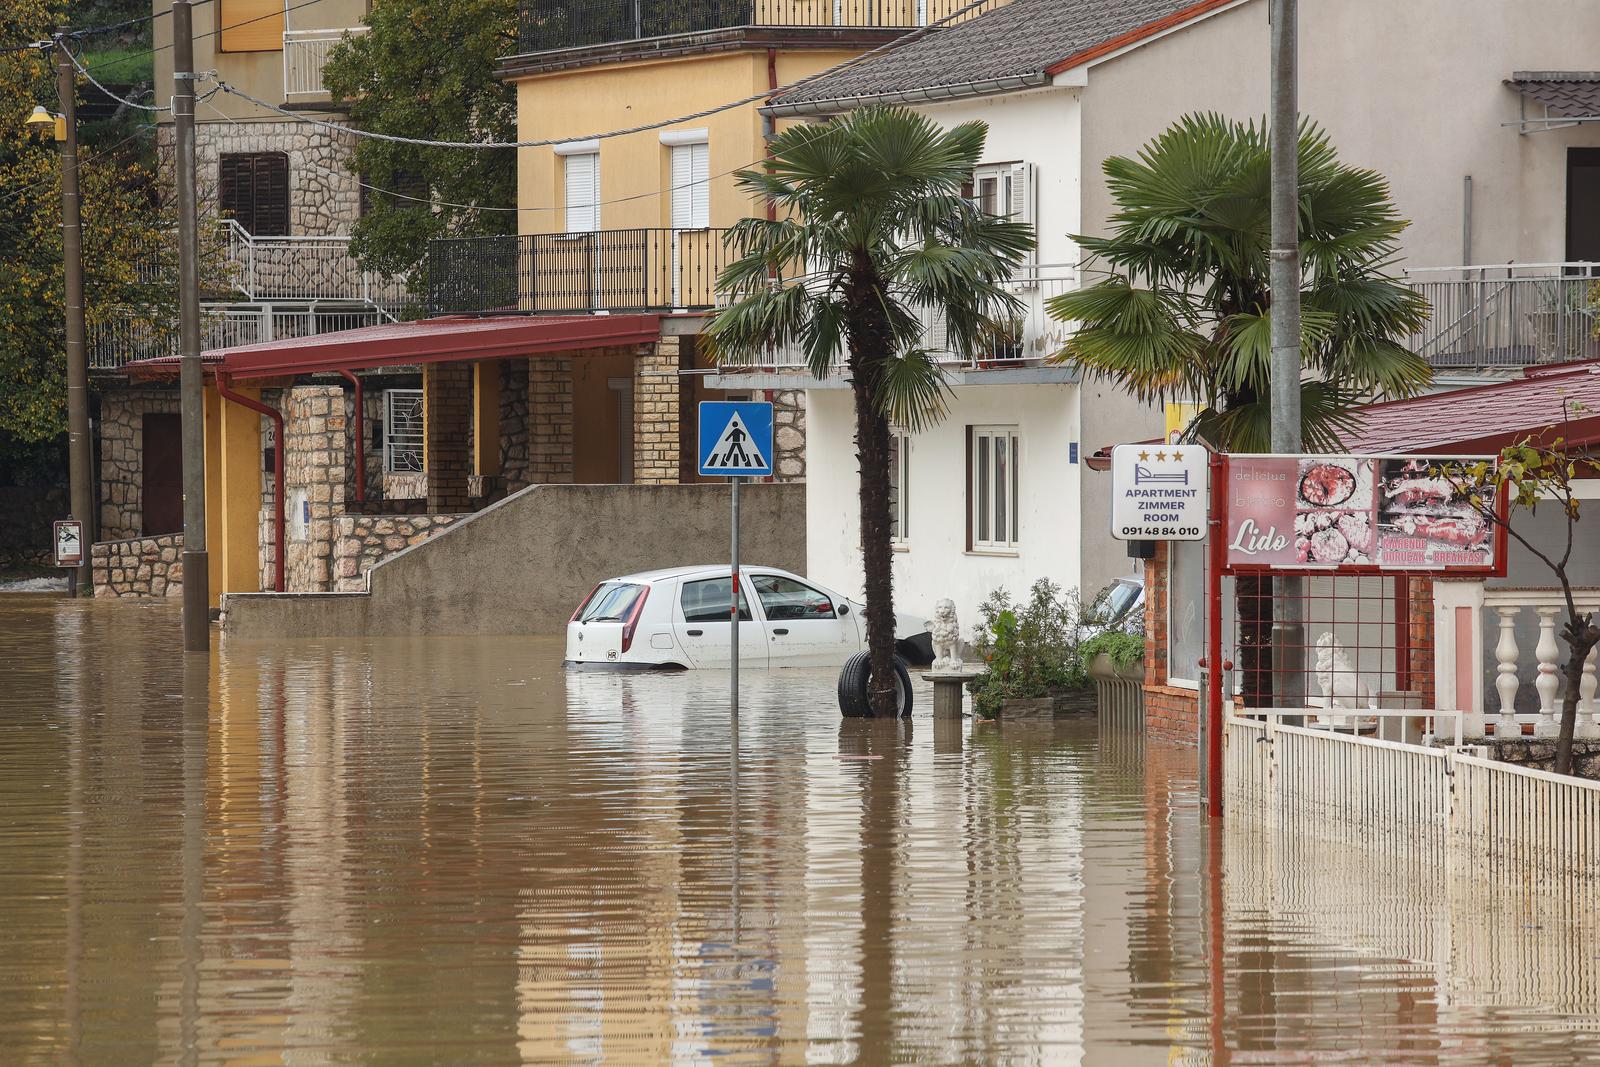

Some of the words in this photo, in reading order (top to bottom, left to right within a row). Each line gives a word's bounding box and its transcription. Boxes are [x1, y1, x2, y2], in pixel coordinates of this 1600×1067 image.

[1235, 465, 1286, 481] delicius
[1125, 489, 1197, 498] APARTMENT
[1235, 487, 1286, 507] biro
[1138, 501, 1185, 510] ZIMMER
[1143, 513, 1179, 522] ROOM
[1122, 526, 1142, 535] 091
[1144, 527, 1160, 536] 48
[1161, 527, 1177, 536] 84
[1179, 527, 1199, 536] 010
[1228, 518, 1290, 555] Lido
[1433, 551, 1485, 563] BREAKFAST
